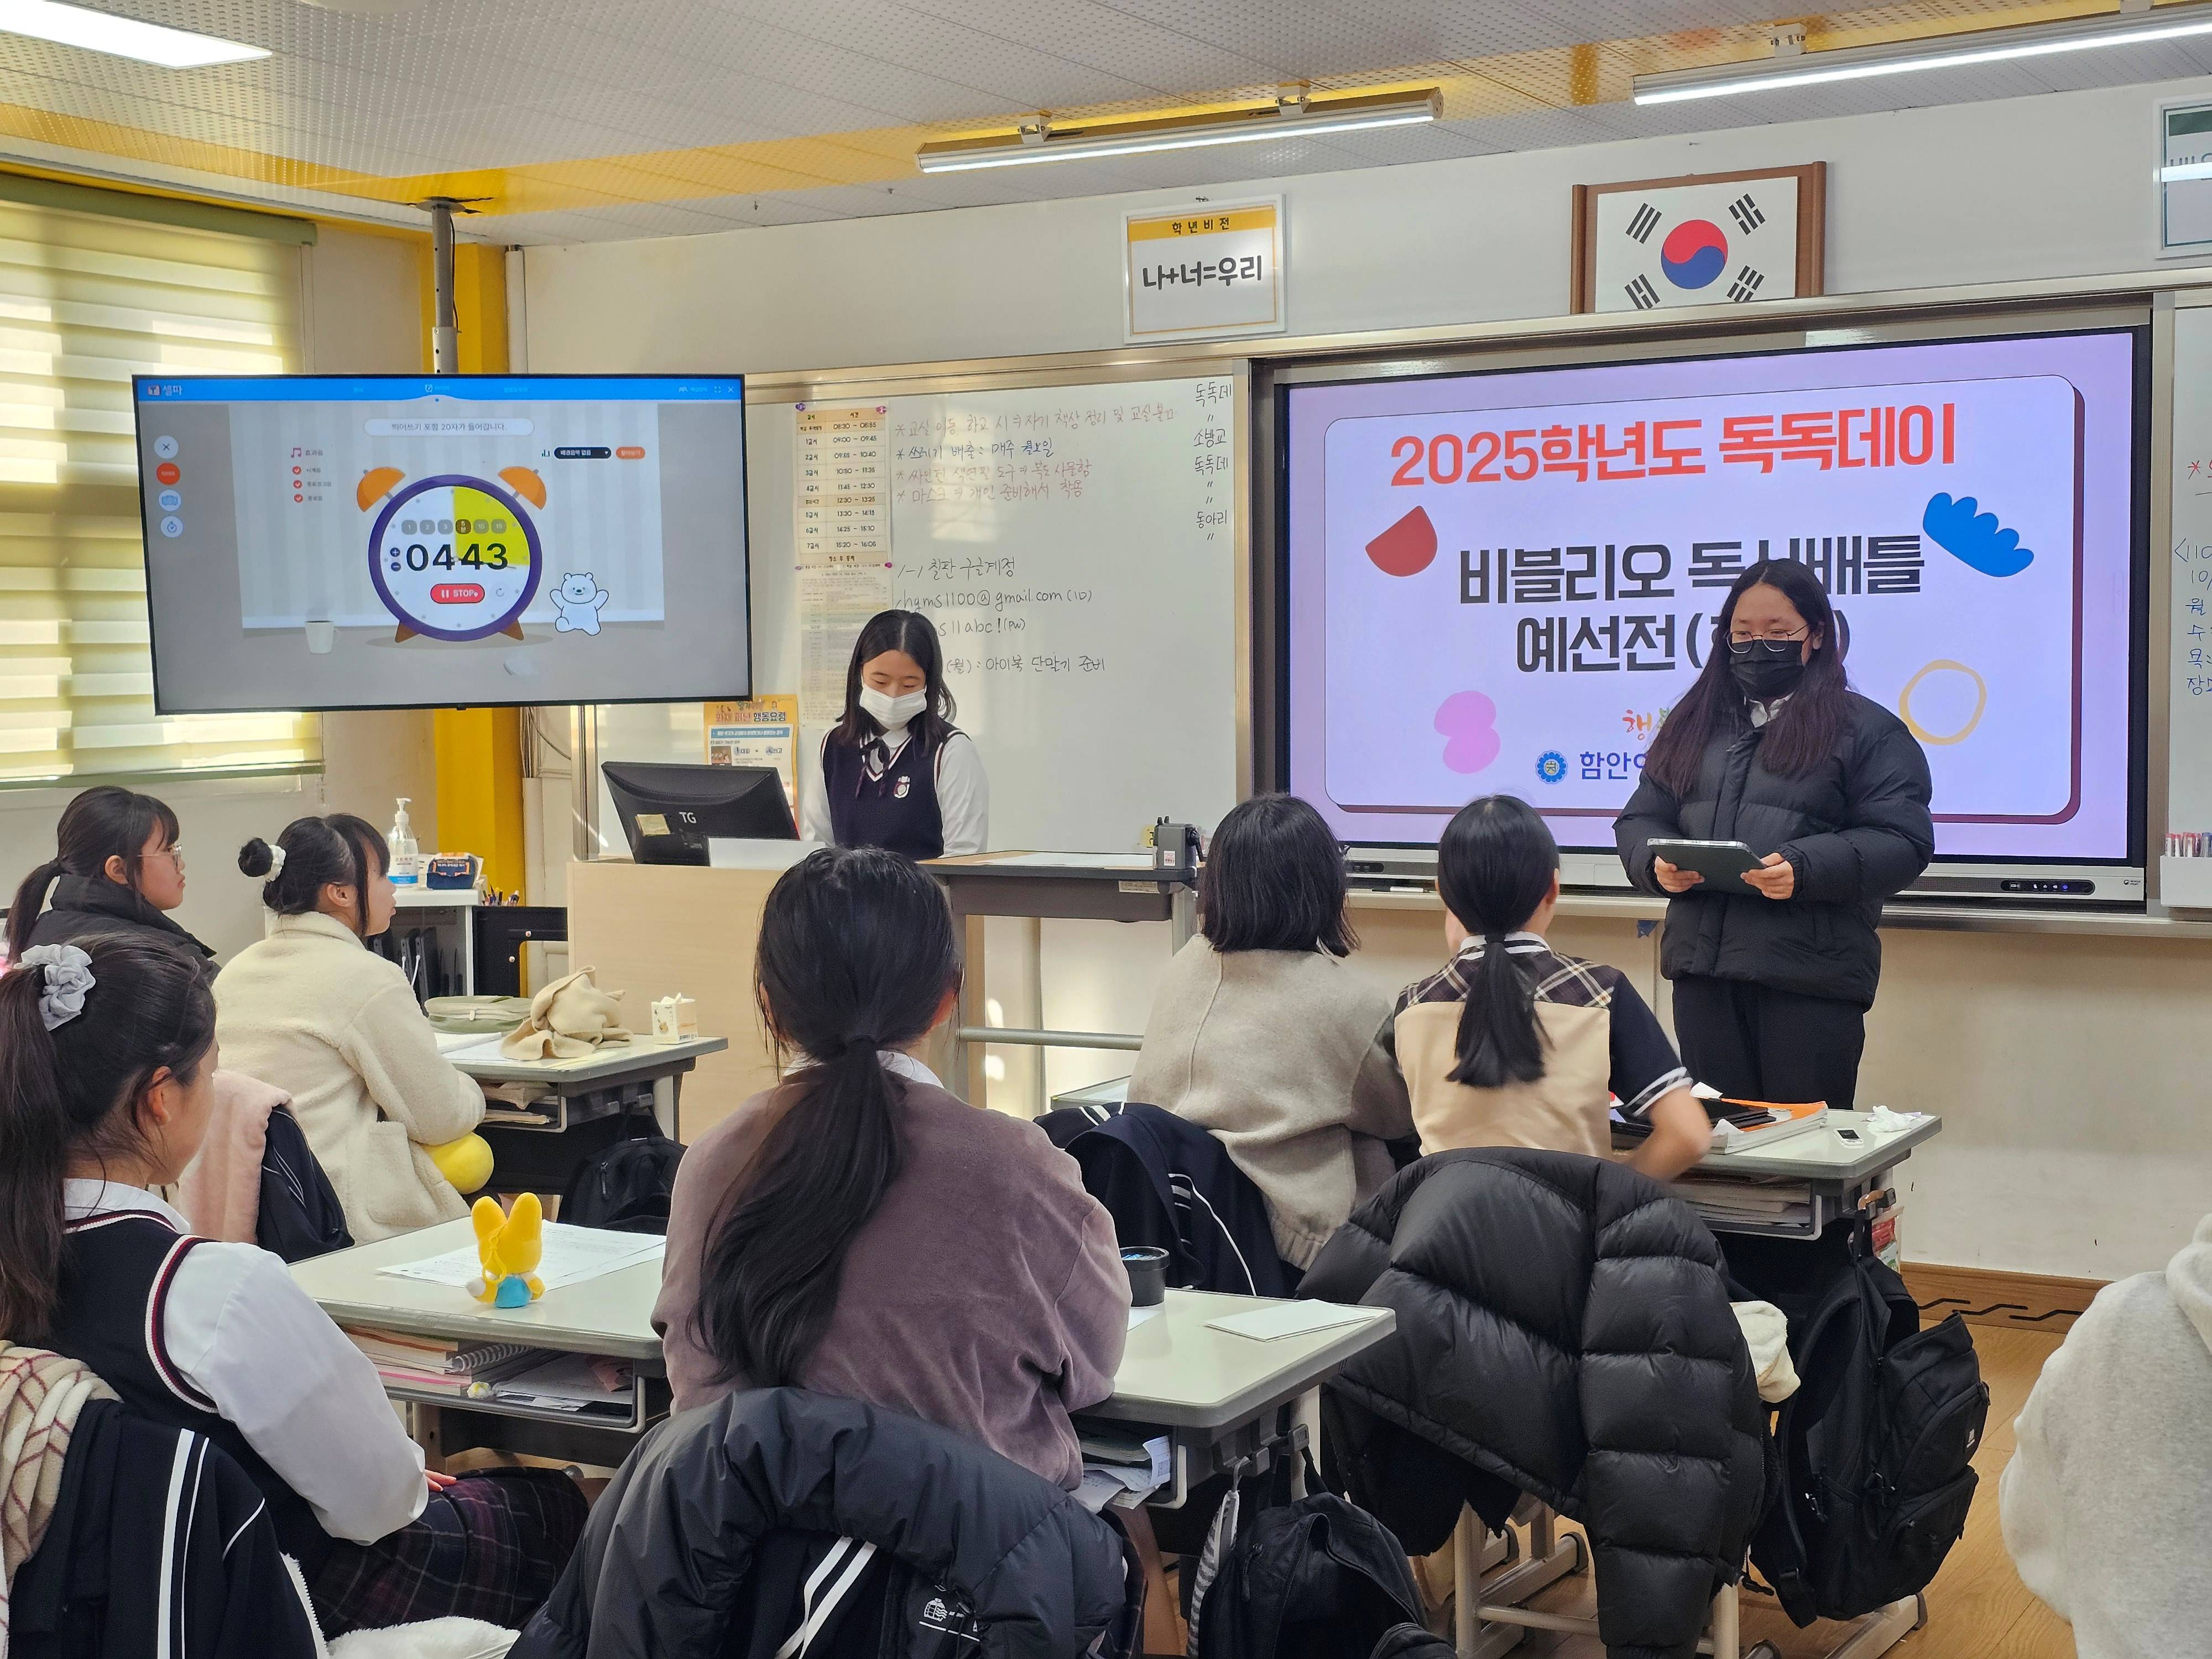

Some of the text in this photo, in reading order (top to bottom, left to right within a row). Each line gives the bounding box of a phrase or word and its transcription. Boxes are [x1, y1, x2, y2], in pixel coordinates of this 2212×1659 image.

[1142, 255, 1261, 290] 나+너=우리
[425, 422, 438, 431] 포함
[1390, 403, 1955, 487] 2025학년도 독독데이
[912, 487, 950, 504] 마스크
[1196, 510, 1227, 529] 동아리
[1460, 543, 1675, 604] 비블리오
[1031, 654, 1070, 672] 단말기
[1079, 655, 1105, 672] 준비
[679, 812, 696, 823] TG
